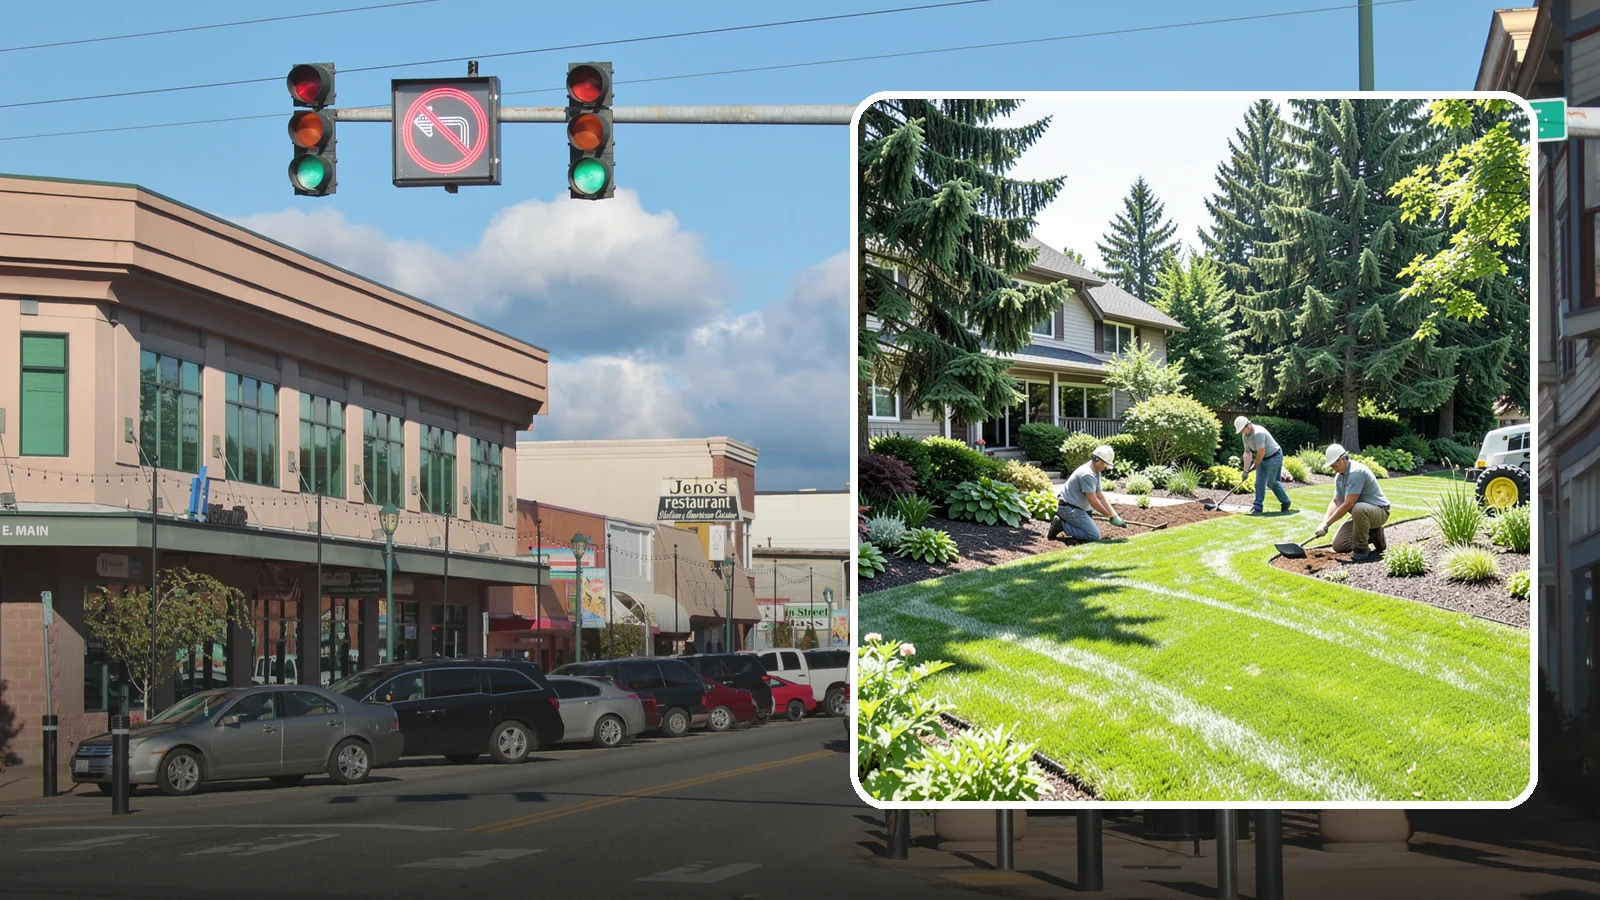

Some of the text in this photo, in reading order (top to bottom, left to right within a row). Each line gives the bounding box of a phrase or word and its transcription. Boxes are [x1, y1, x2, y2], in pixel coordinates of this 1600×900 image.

[669, 480, 727, 495] Jeno's
[665, 496, 731, 509] restaurant
[714, 509, 738, 519] Cuisine
[2, 525, 49, 536] E. MAIN
[797, 607, 828, 617] Street
